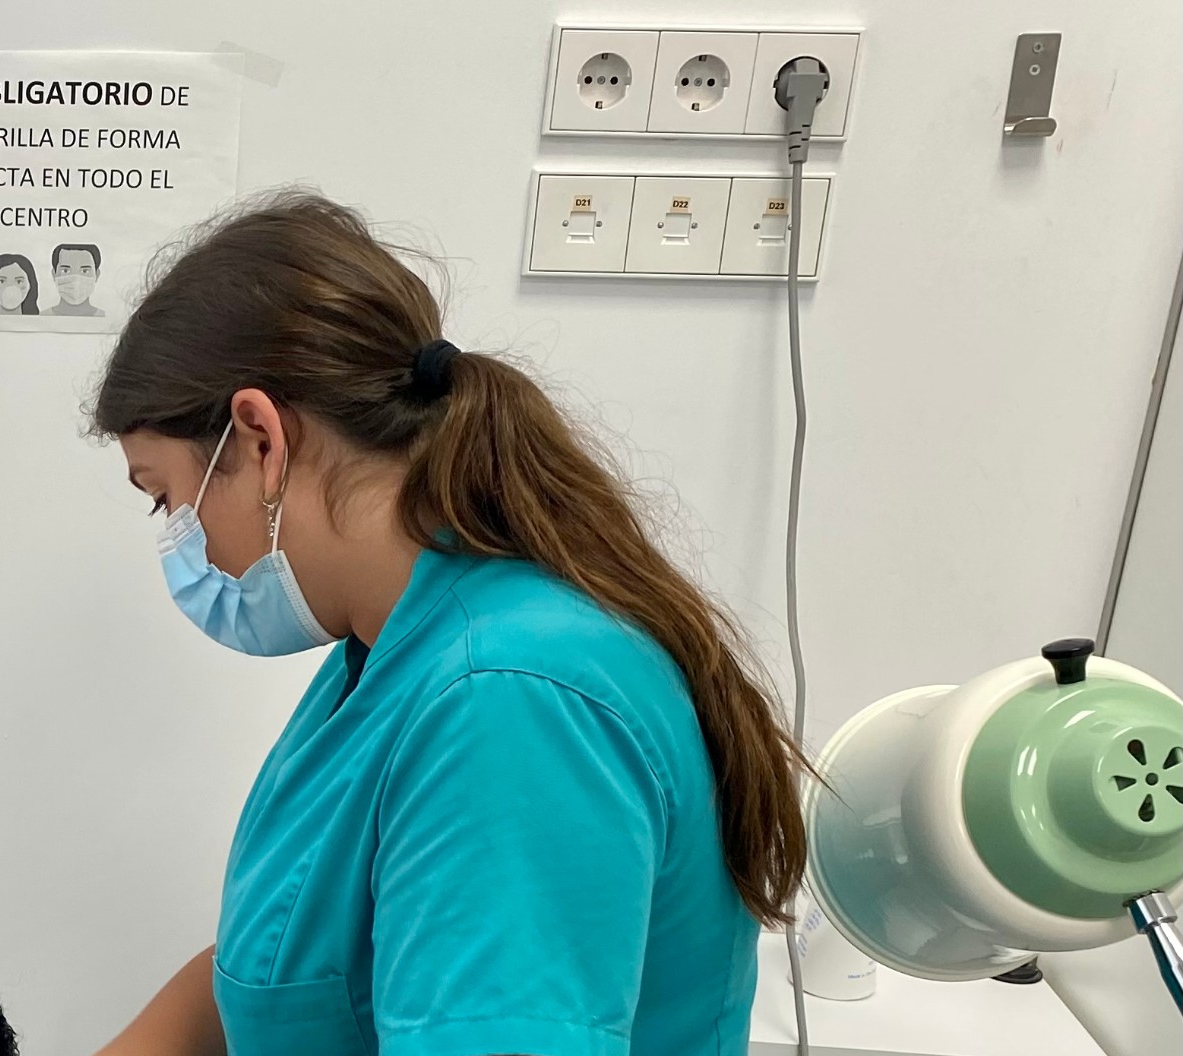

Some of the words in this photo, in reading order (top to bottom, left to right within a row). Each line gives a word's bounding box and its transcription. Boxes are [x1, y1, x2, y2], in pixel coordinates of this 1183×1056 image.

[160, 86, 190, 107] DE
[61, 128, 90, 149] DE
[97, 129, 181, 150] FORMA
[42, 168, 70, 188] EN
[77, 168, 143, 189] TODO
[150, 169, 174, 189] EL
[575, 198, 591, 207] D21
[672, 200, 689, 209] D22
[768, 202, 785, 210] D23
[0, 207, 88, 228] CENTRO
